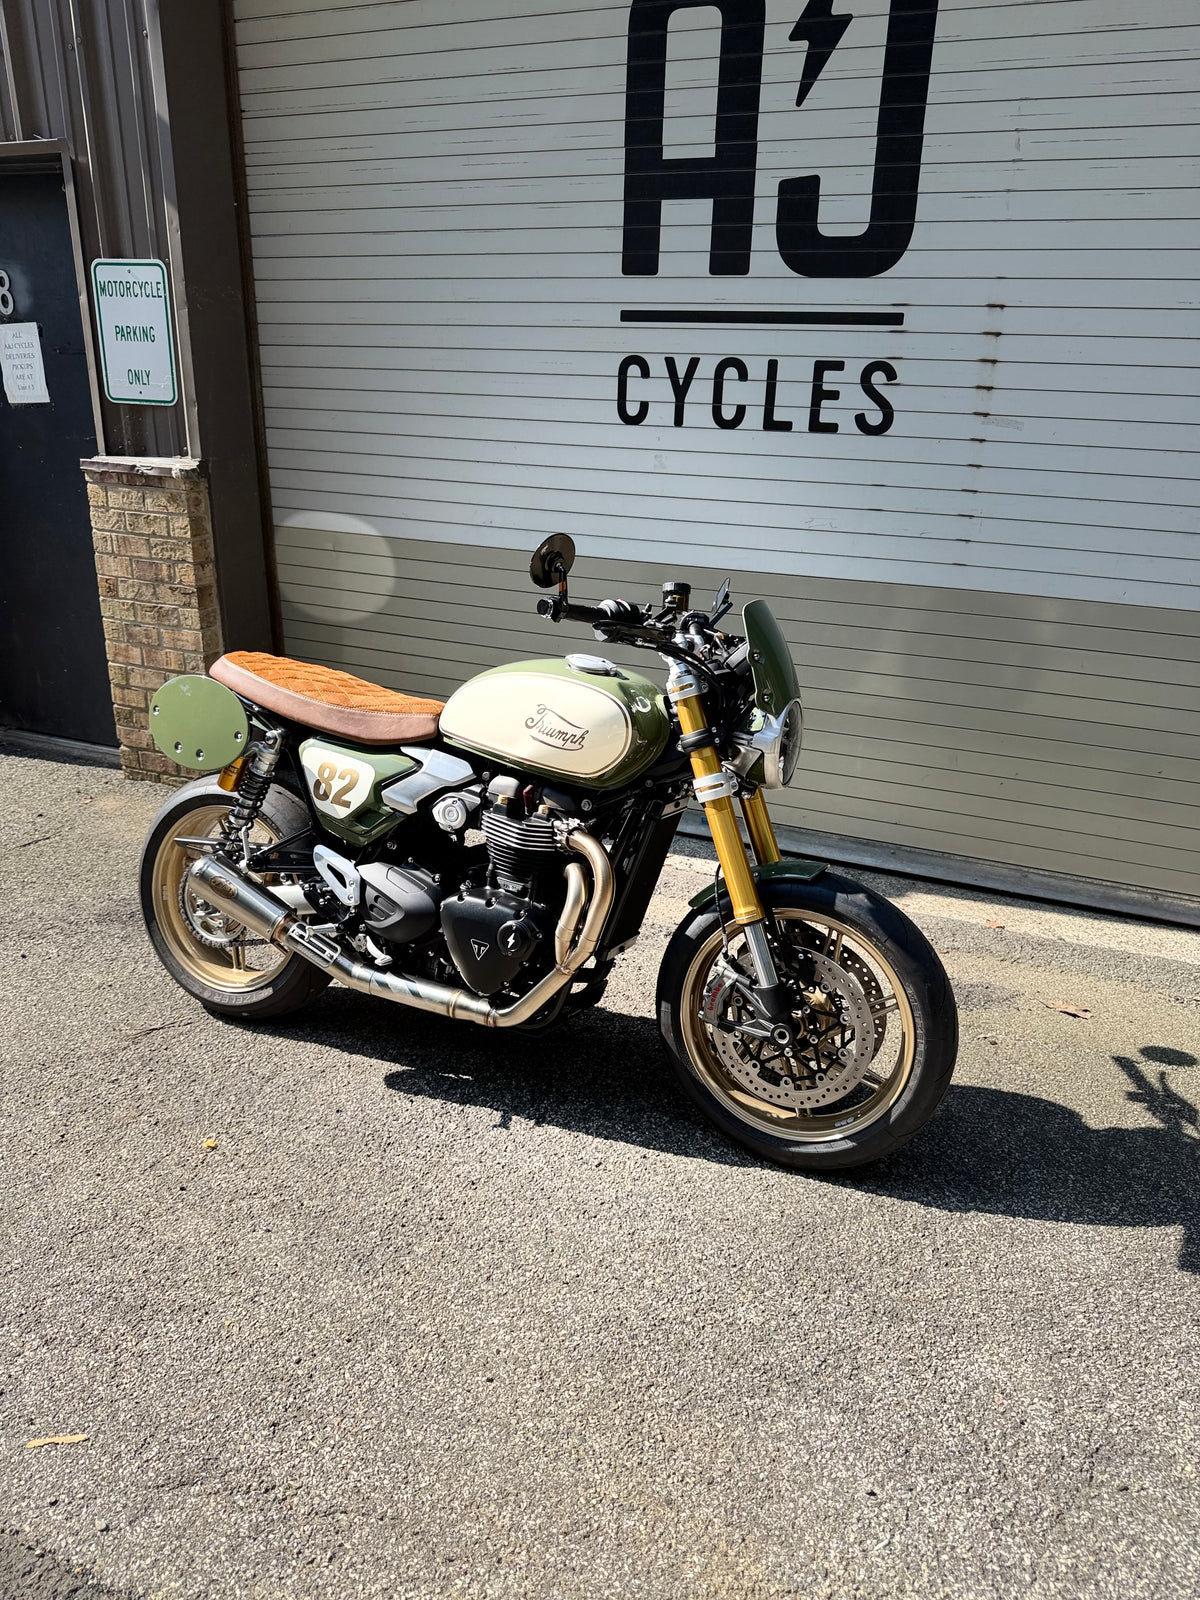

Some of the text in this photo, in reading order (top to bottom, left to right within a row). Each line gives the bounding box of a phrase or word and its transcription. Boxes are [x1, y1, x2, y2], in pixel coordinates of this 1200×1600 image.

[99, 280, 162, 298] MOTORCYCLE
[114, 325, 156, 343] PARKING
[127, 368, 151, 386] ONLY
[616, 354, 899, 436] CYCLES
[524, 703, 590, 752] Triumph
[313, 762, 360, 809] 82
